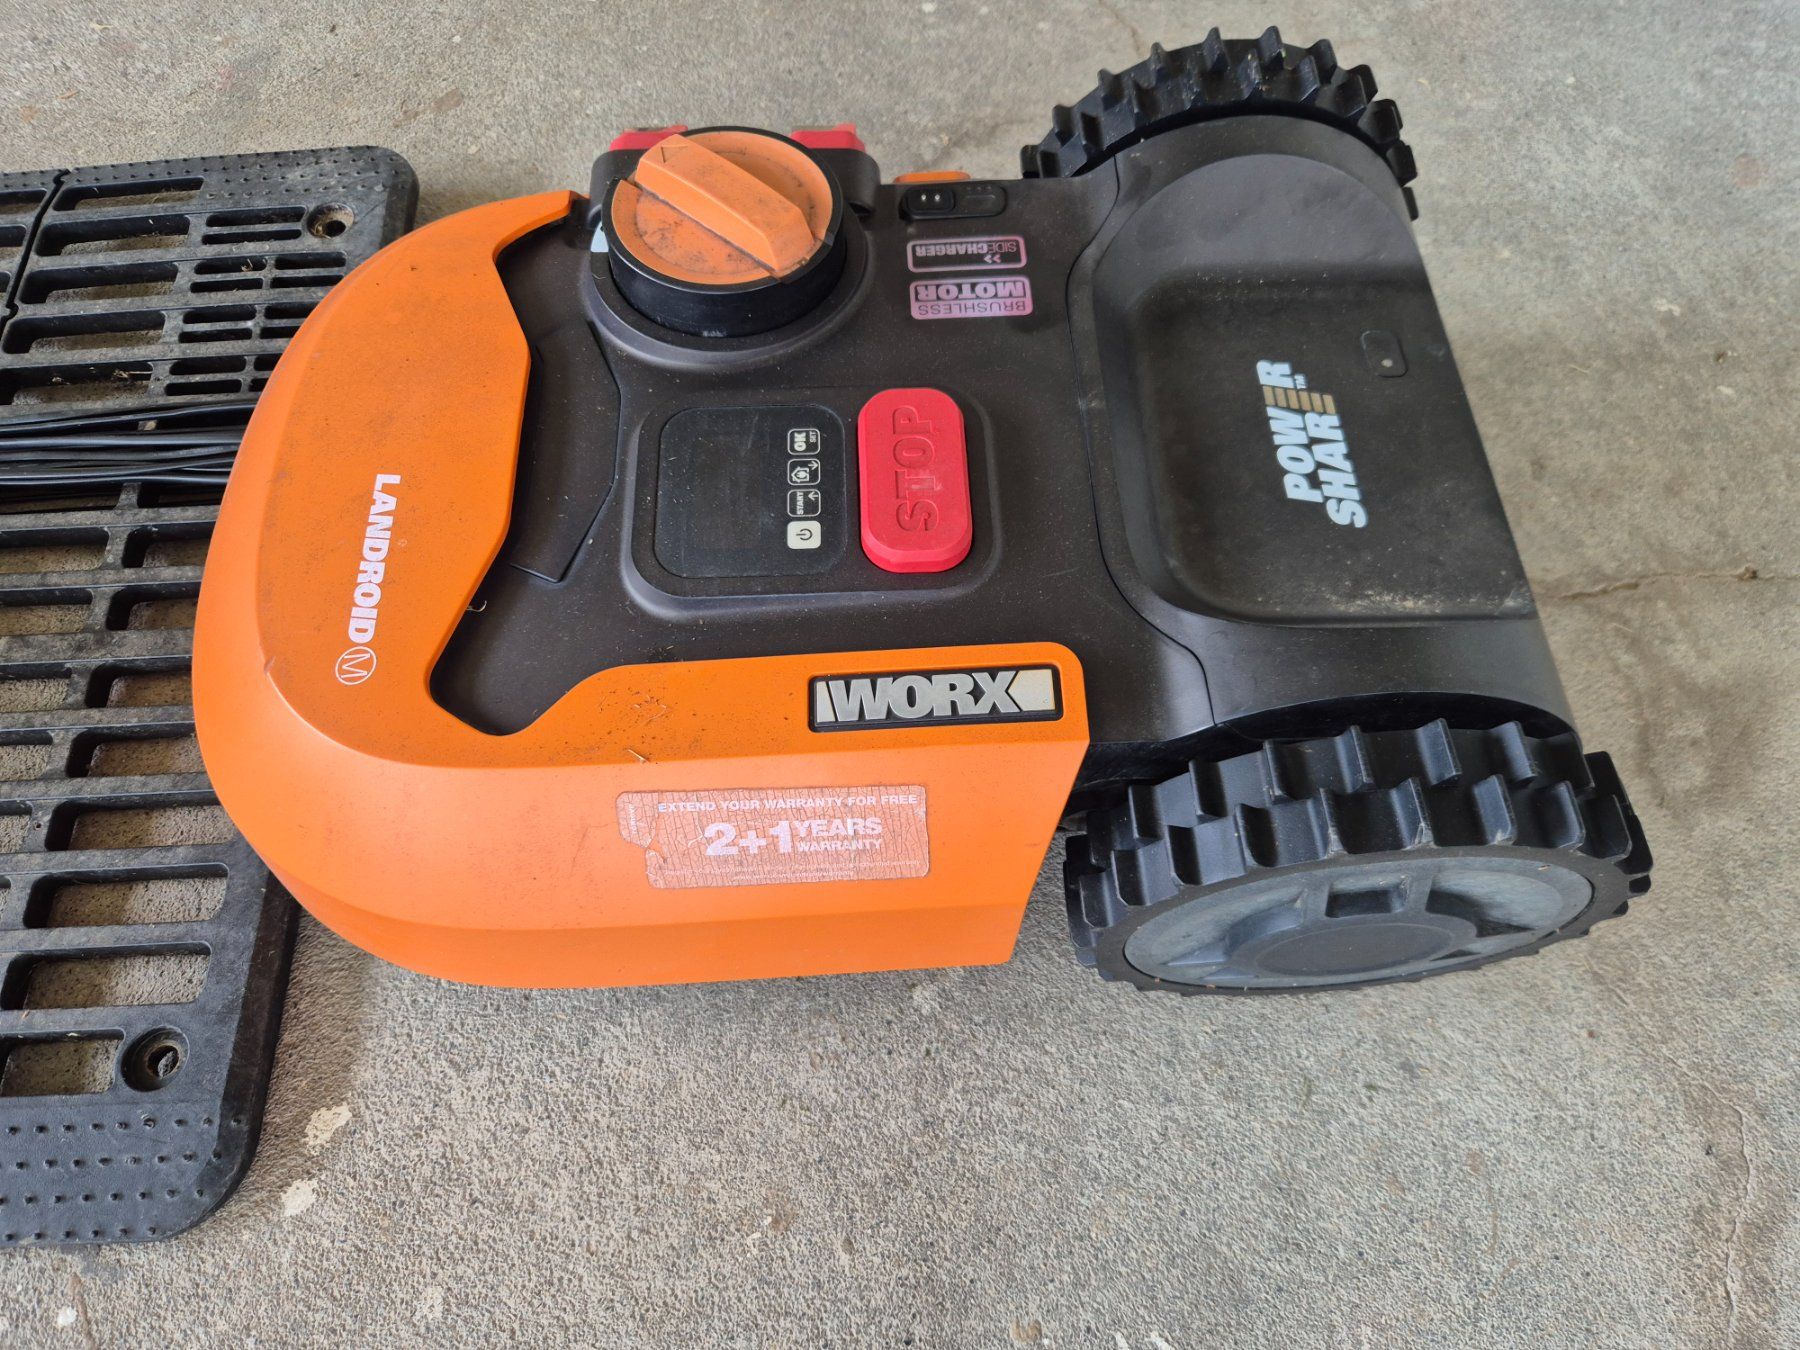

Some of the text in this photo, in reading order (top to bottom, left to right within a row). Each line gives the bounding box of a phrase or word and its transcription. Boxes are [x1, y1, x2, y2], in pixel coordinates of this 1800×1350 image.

[914, 241, 1017, 257] SIDECHARGER
[915, 281, 1026, 301] MOTOR
[917, 300, 1027, 316] BRUSHLESS
[793, 431, 807, 452] OK
[892, 404, 940, 532] STOP
[796, 491, 805, 515] START
[348, 473, 402, 645] LANDROID
[826, 669, 1022, 722] WORX
[657, 794, 918, 813] EXTEND YOUR WARRANTY FOR FREE
[703, 819, 792, 856] 2+1
[792, 817, 883, 838] YEARS
[795, 838, 882, 852] WARRANTY
